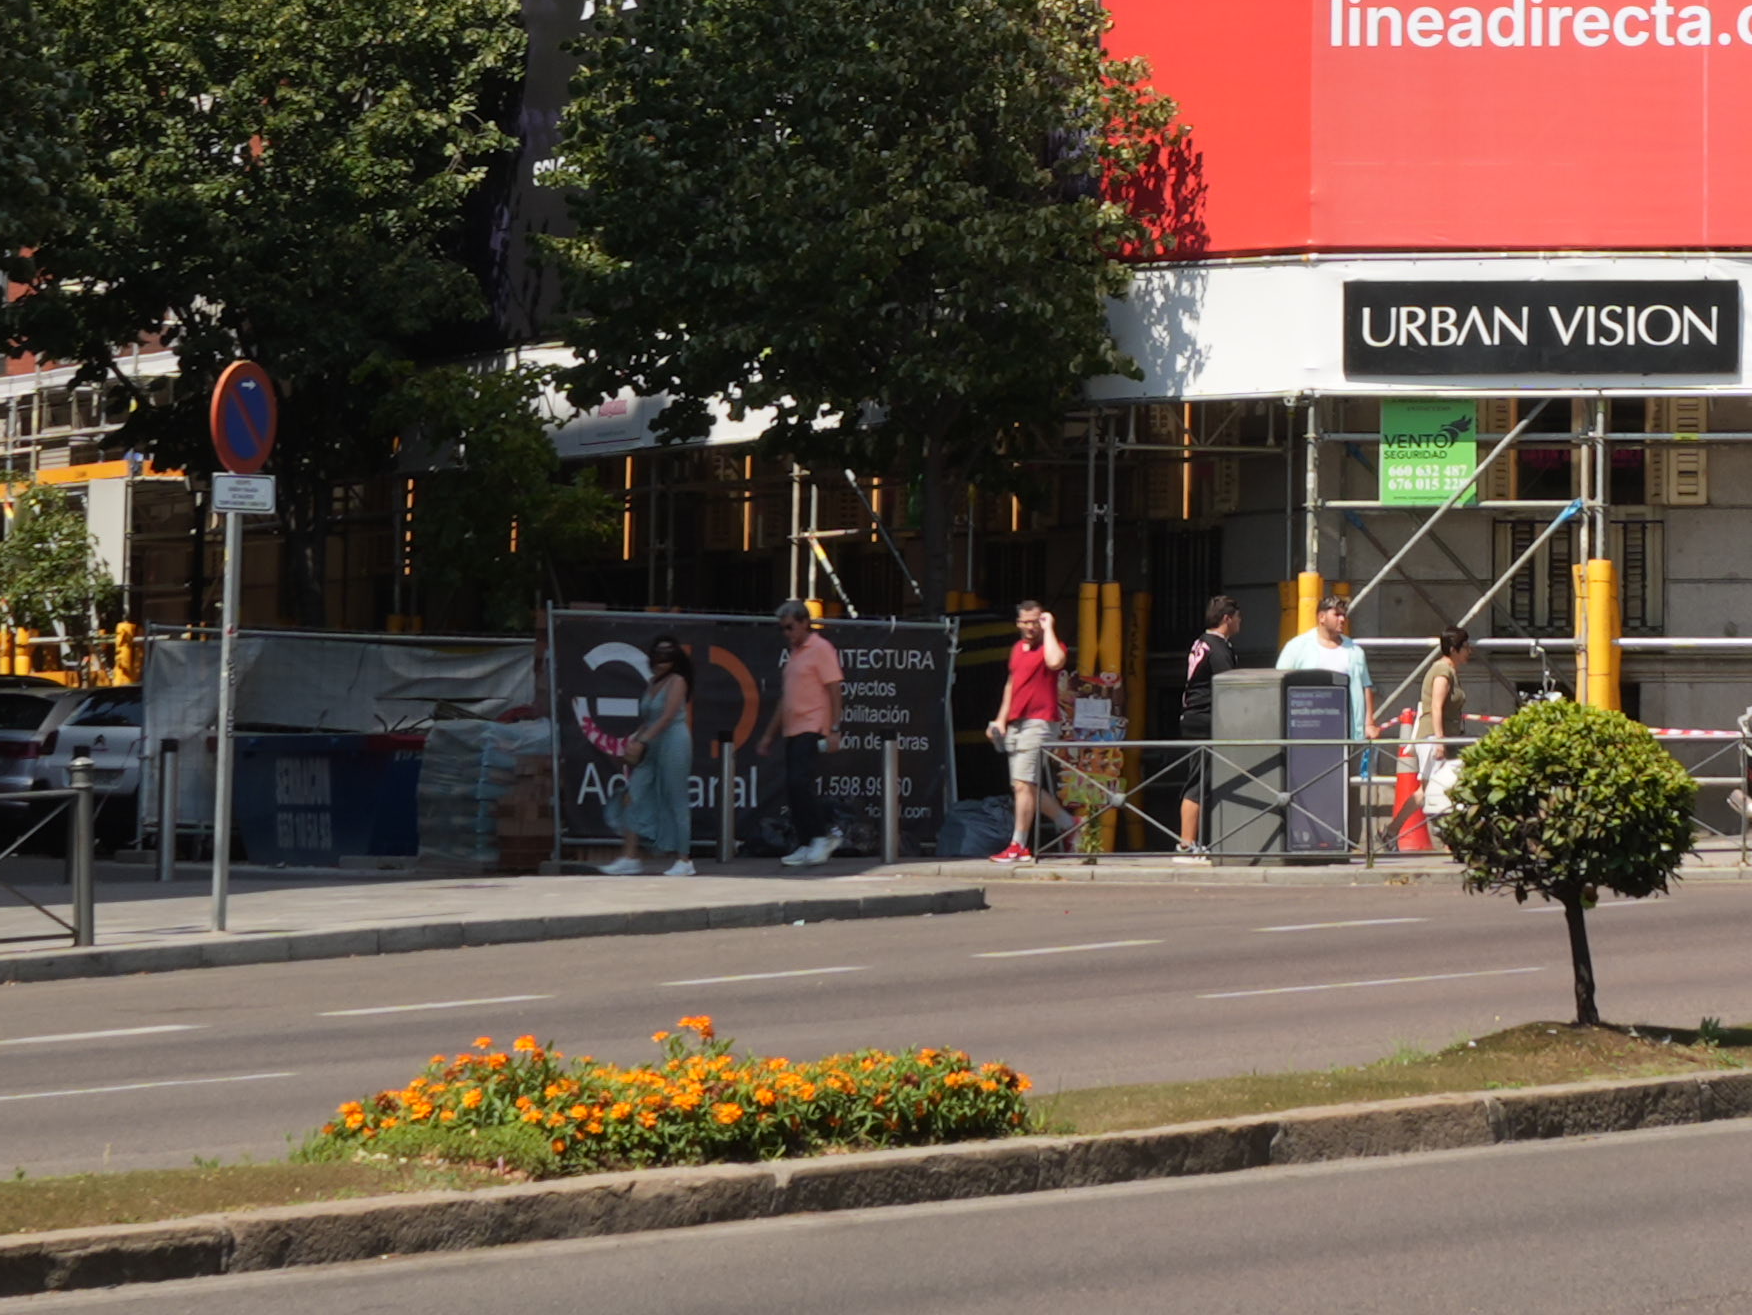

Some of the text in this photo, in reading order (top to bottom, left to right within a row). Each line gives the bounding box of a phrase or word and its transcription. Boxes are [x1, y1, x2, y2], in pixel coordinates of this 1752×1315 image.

[1361, 303, 1720, 348] URBAN VISION
[1384, 433, 1448, 449] VENTO
[1384, 450, 1448, 459] SEGURIDAD
[1388, 478, 1413, 490] 676
[864, 732, 882, 751] de
